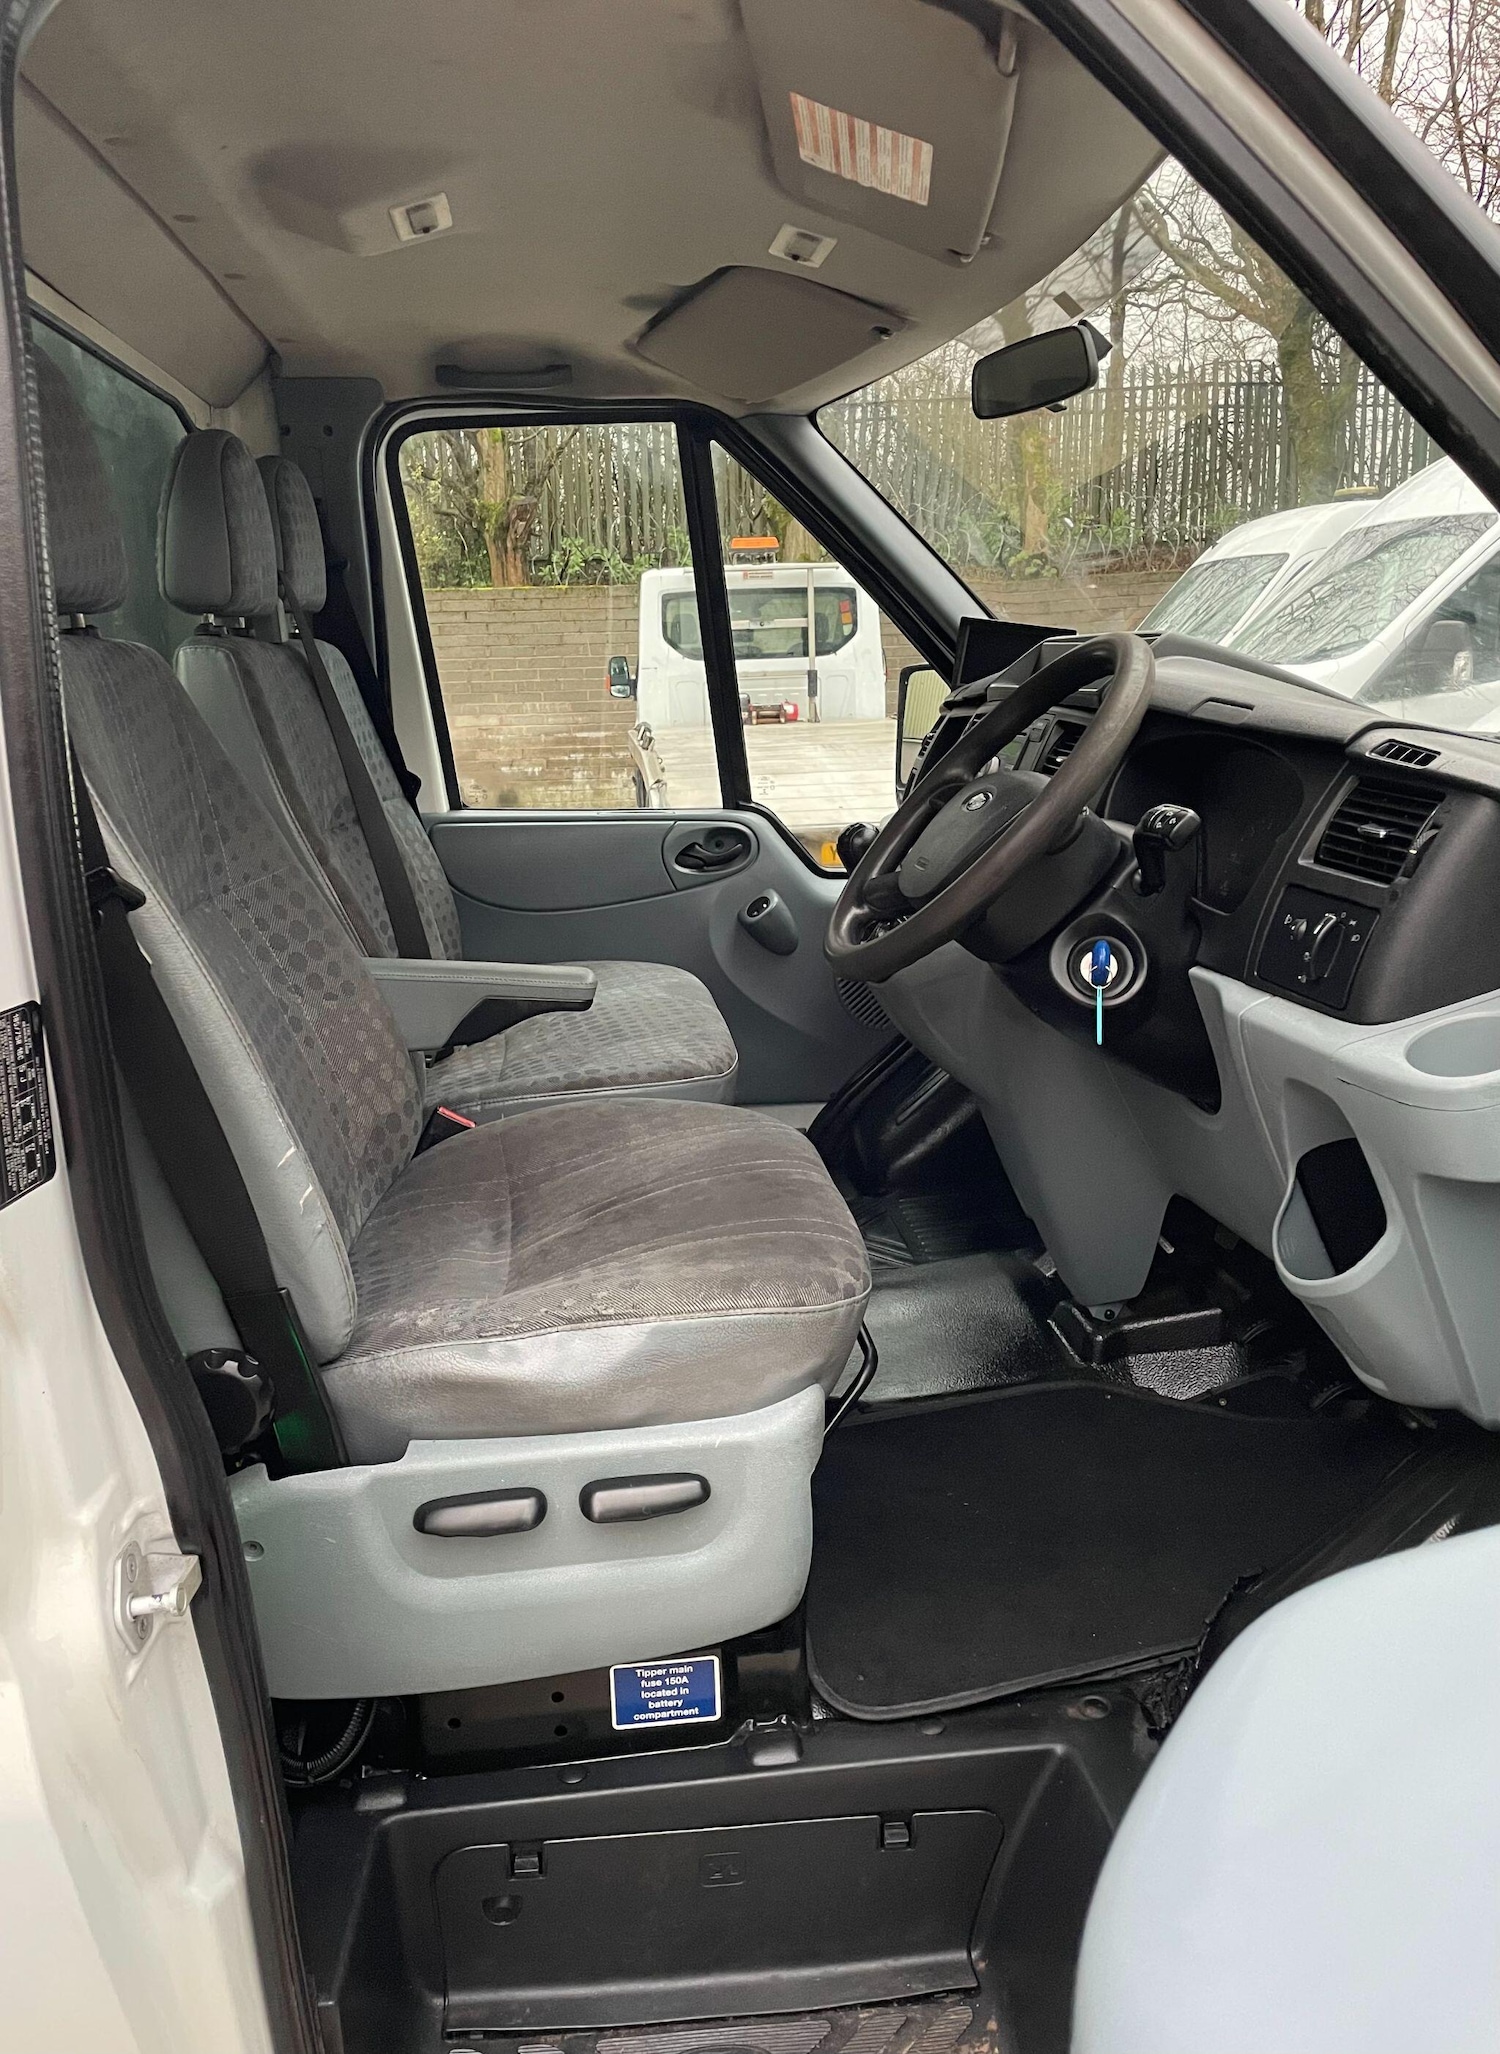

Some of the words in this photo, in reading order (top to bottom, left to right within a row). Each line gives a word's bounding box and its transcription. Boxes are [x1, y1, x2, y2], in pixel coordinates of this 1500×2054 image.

[635, 1669, 667, 1678] Tipper
[669, 1665, 693, 1675] main
[640, 1679, 662, 1688] fuse
[664, 1675, 689, 1686] 150A
[641, 1688, 677, 1699] located
[680, 1687, 689, 1695] in
[648, 1698, 683, 1710] battery
[633, 1707, 699, 1721] compartment
